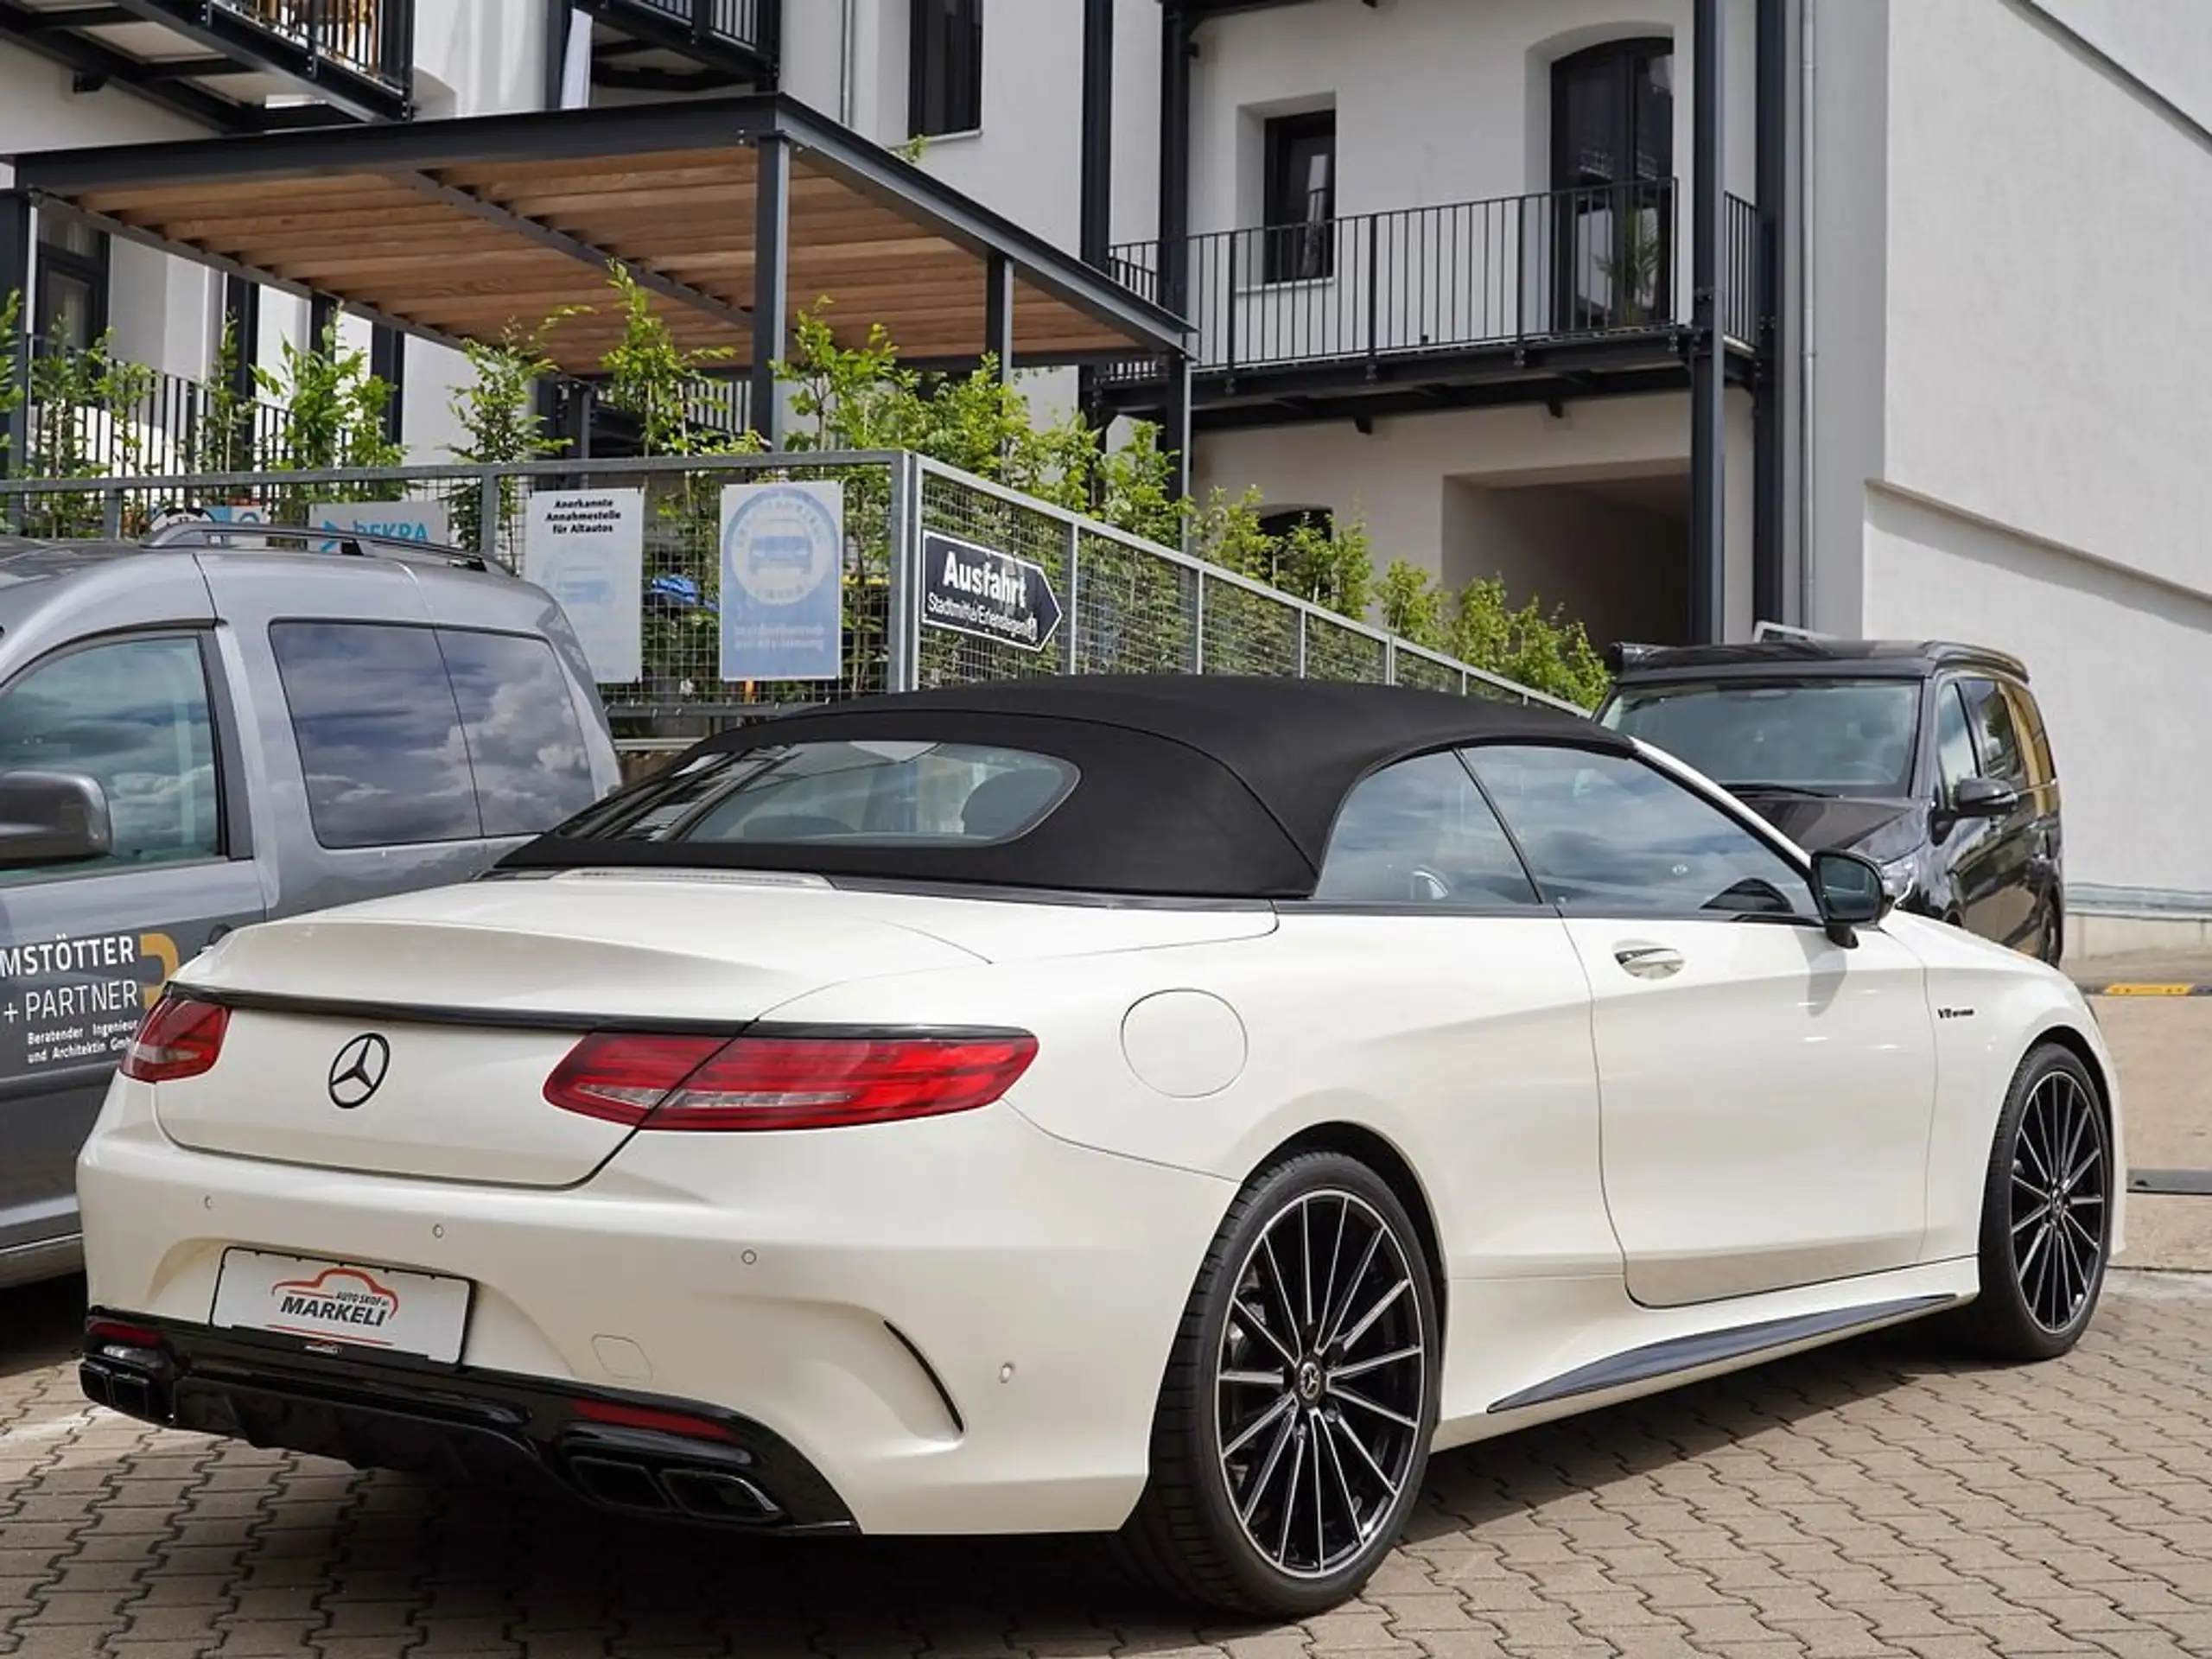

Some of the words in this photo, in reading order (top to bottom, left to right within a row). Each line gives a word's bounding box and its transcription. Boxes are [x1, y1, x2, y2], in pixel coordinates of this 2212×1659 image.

[555, 499, 614, 508] Anerkannte
[545, 510, 621, 521] Annahmestelle
[570, 524, 613, 534] Altautos
[942, 550, 1027, 608] Ausfahrt
[0, 933, 135, 978] MSTÖTTER
[25, 979, 138, 1021] PARTNER
[27, 1027, 84, 1045] Beratender
[27, 1049, 48, 1065] und
[52, 1039, 107, 1060] Architektin
[110, 1036, 133, 1052] Gmb
[336, 1291, 359, 1303] AUTO
[359, 1295, 382, 1306] SHOP
[280, 1296, 386, 1327] MARKELI
